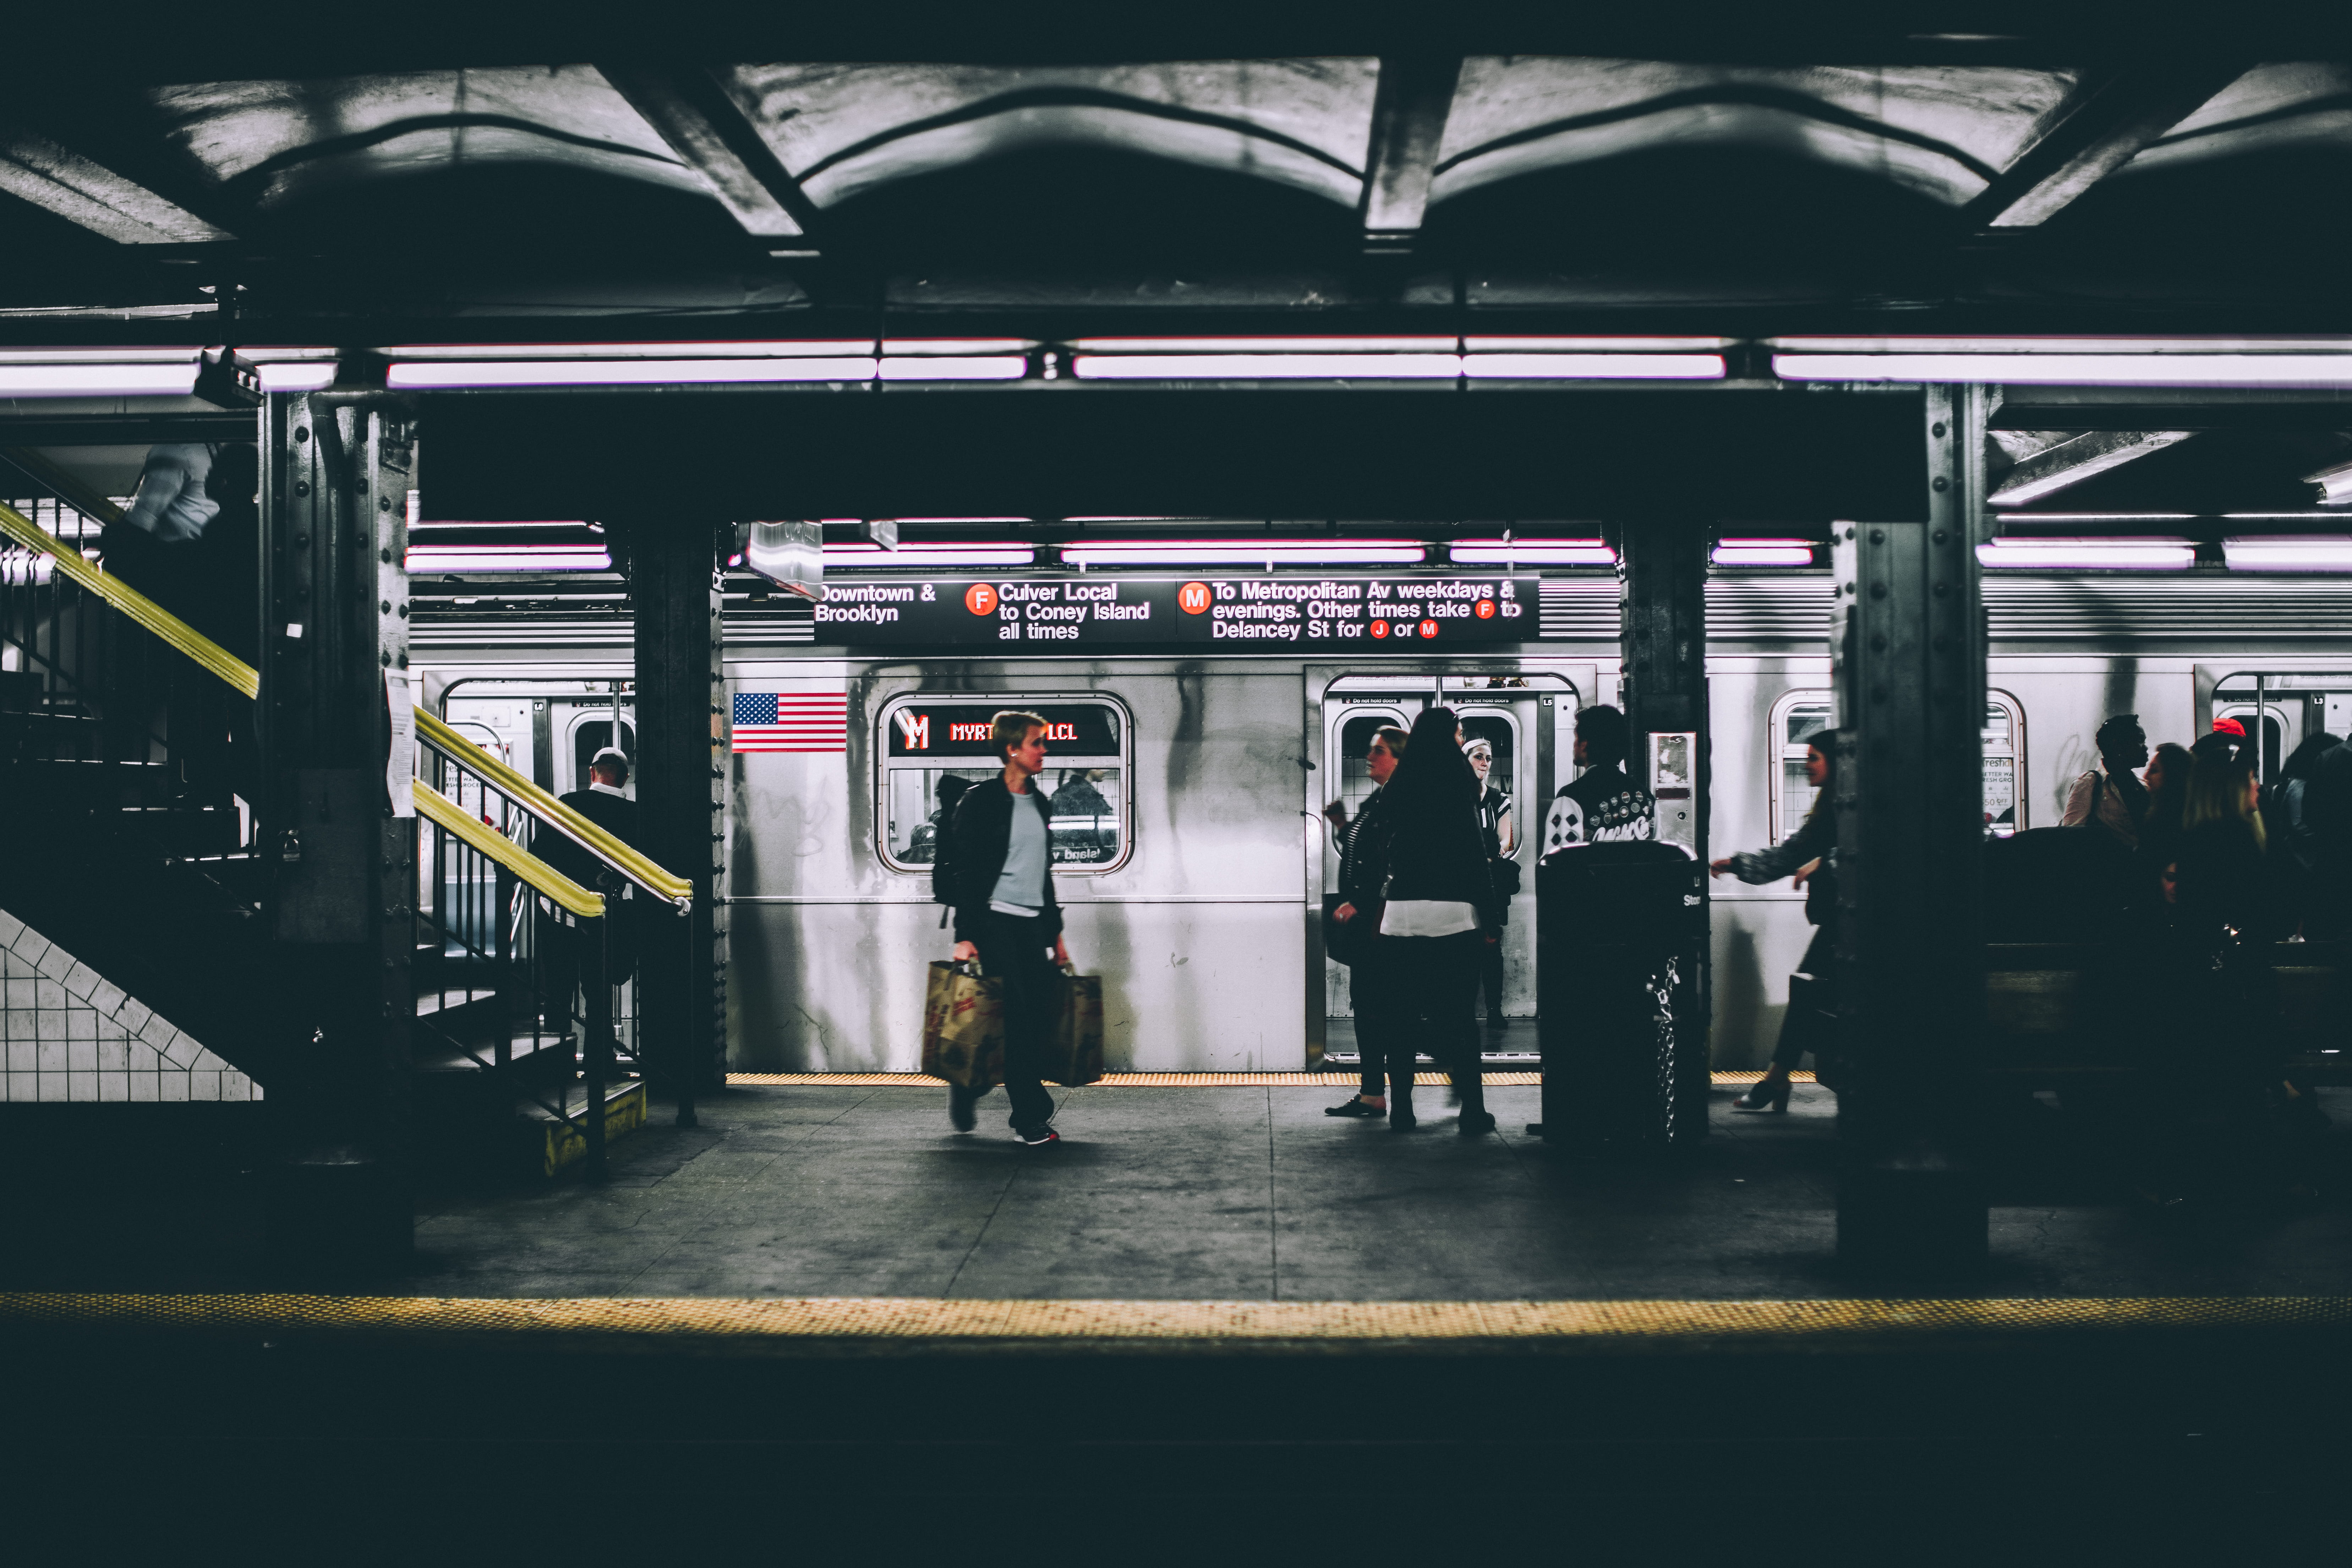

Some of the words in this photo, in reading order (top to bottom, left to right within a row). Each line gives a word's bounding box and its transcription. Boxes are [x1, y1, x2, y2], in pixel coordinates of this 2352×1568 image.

[921, 584, 936, 601] &
[976, 591, 989, 609] F
[999, 583, 1059, 601] Culver
[1065, 583, 1117, 601] Local
[1186, 589, 1204, 607] M
[1213, 582, 1236, 599] To
[1242, 581, 1361, 603] Metropolitan
[1367, 581, 1391, 599] Av
[1397, 581, 1493, 602] weekdays
[1500, 580, 1515, 598] &
[815, 604, 898, 625] Brooklyn
[999, 604, 1019, 620] to
[1026, 603, 1087, 624] Coney
[1094, 602, 1149, 620] Island
[1213, 601, 1301, 622] evenings.
[1307, 601, 1362, 618] Other
[1368, 601, 1420, 618] times
[1427, 600, 1471, 618] take
[1481, 604, 1490, 616] F
[1500, 601, 1521, 617] to
[999, 622, 1019, 639] all
[1027, 622, 1079, 639] times
[1213, 620, 1301, 641] Delancey
[1308, 620, 1329, 637] St
[1336, 620, 1364, 637] for
[1376, 624, 1383, 635] J
[1394, 624, 1415, 637] or
[1423, 623, 1434, 635] M
[906, 715, 929, 749] M
